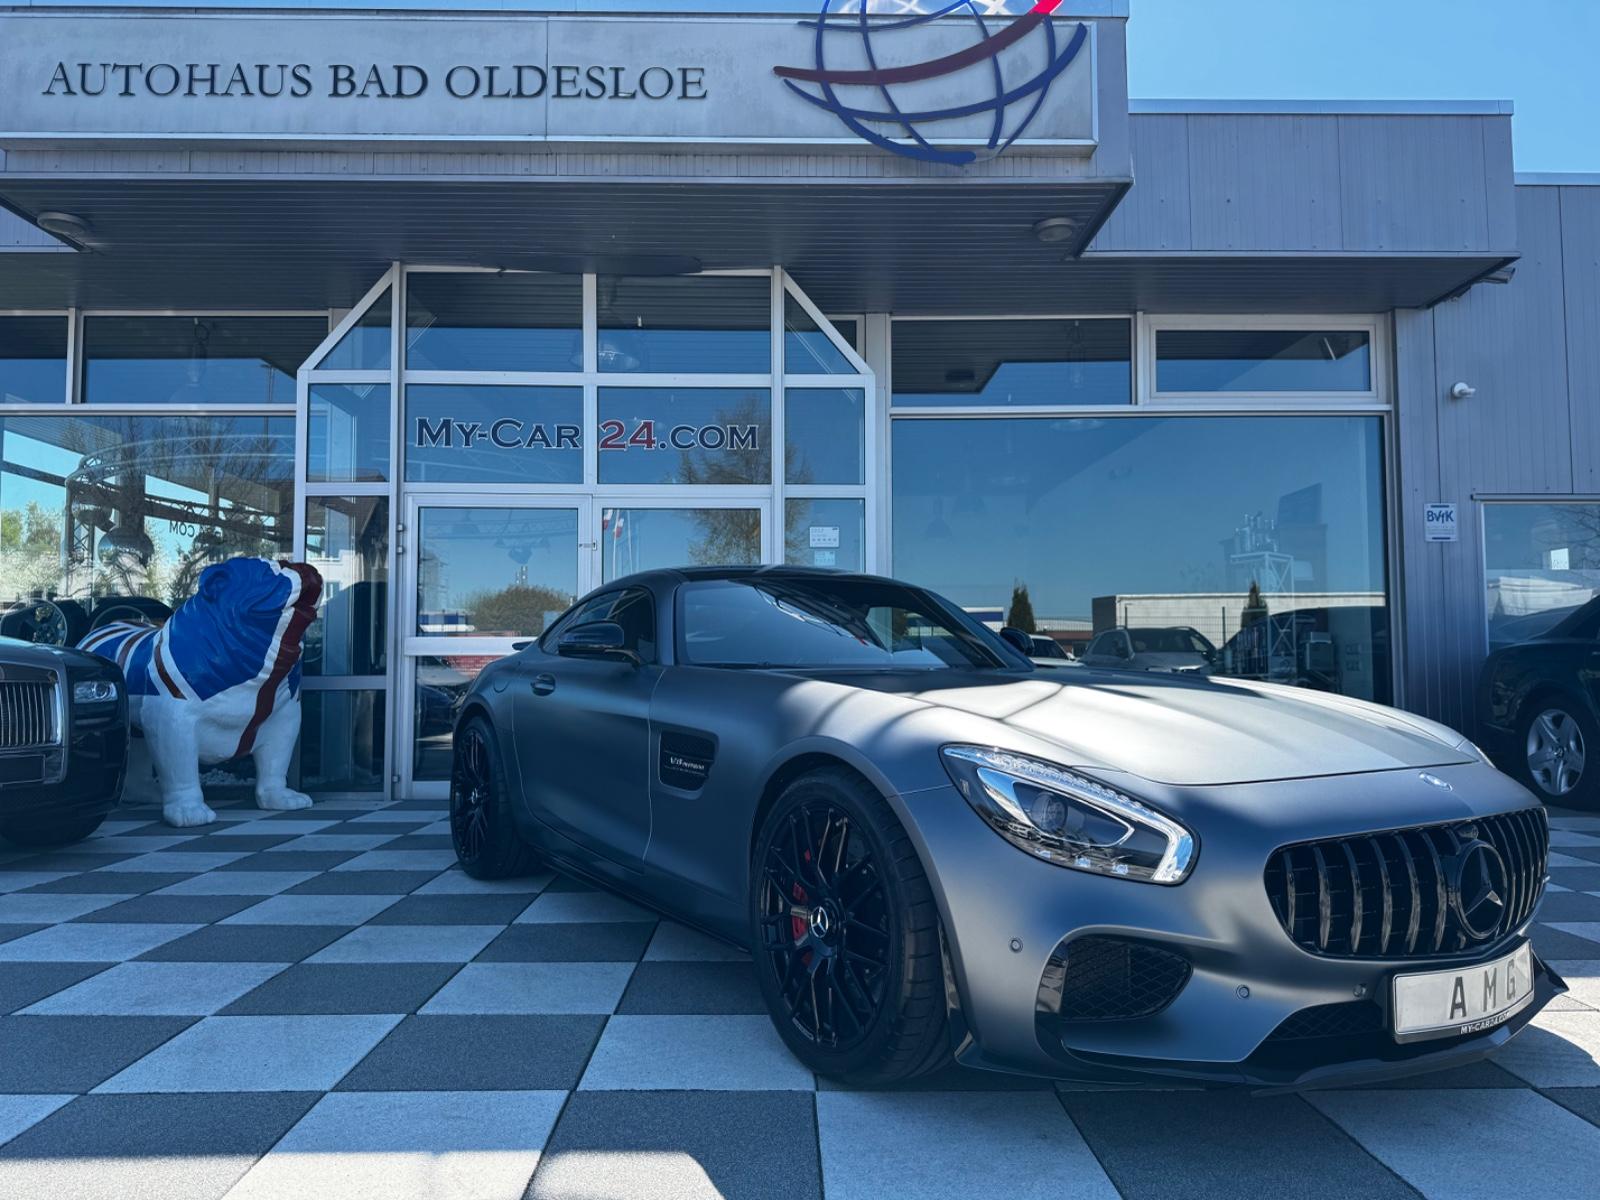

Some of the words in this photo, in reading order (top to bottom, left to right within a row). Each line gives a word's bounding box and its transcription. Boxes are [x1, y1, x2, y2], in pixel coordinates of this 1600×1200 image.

[42, 61, 313, 98] AUTOHAUS
[327, 63, 429, 98] BAD
[444, 65, 708, 101] OLDESLOE
